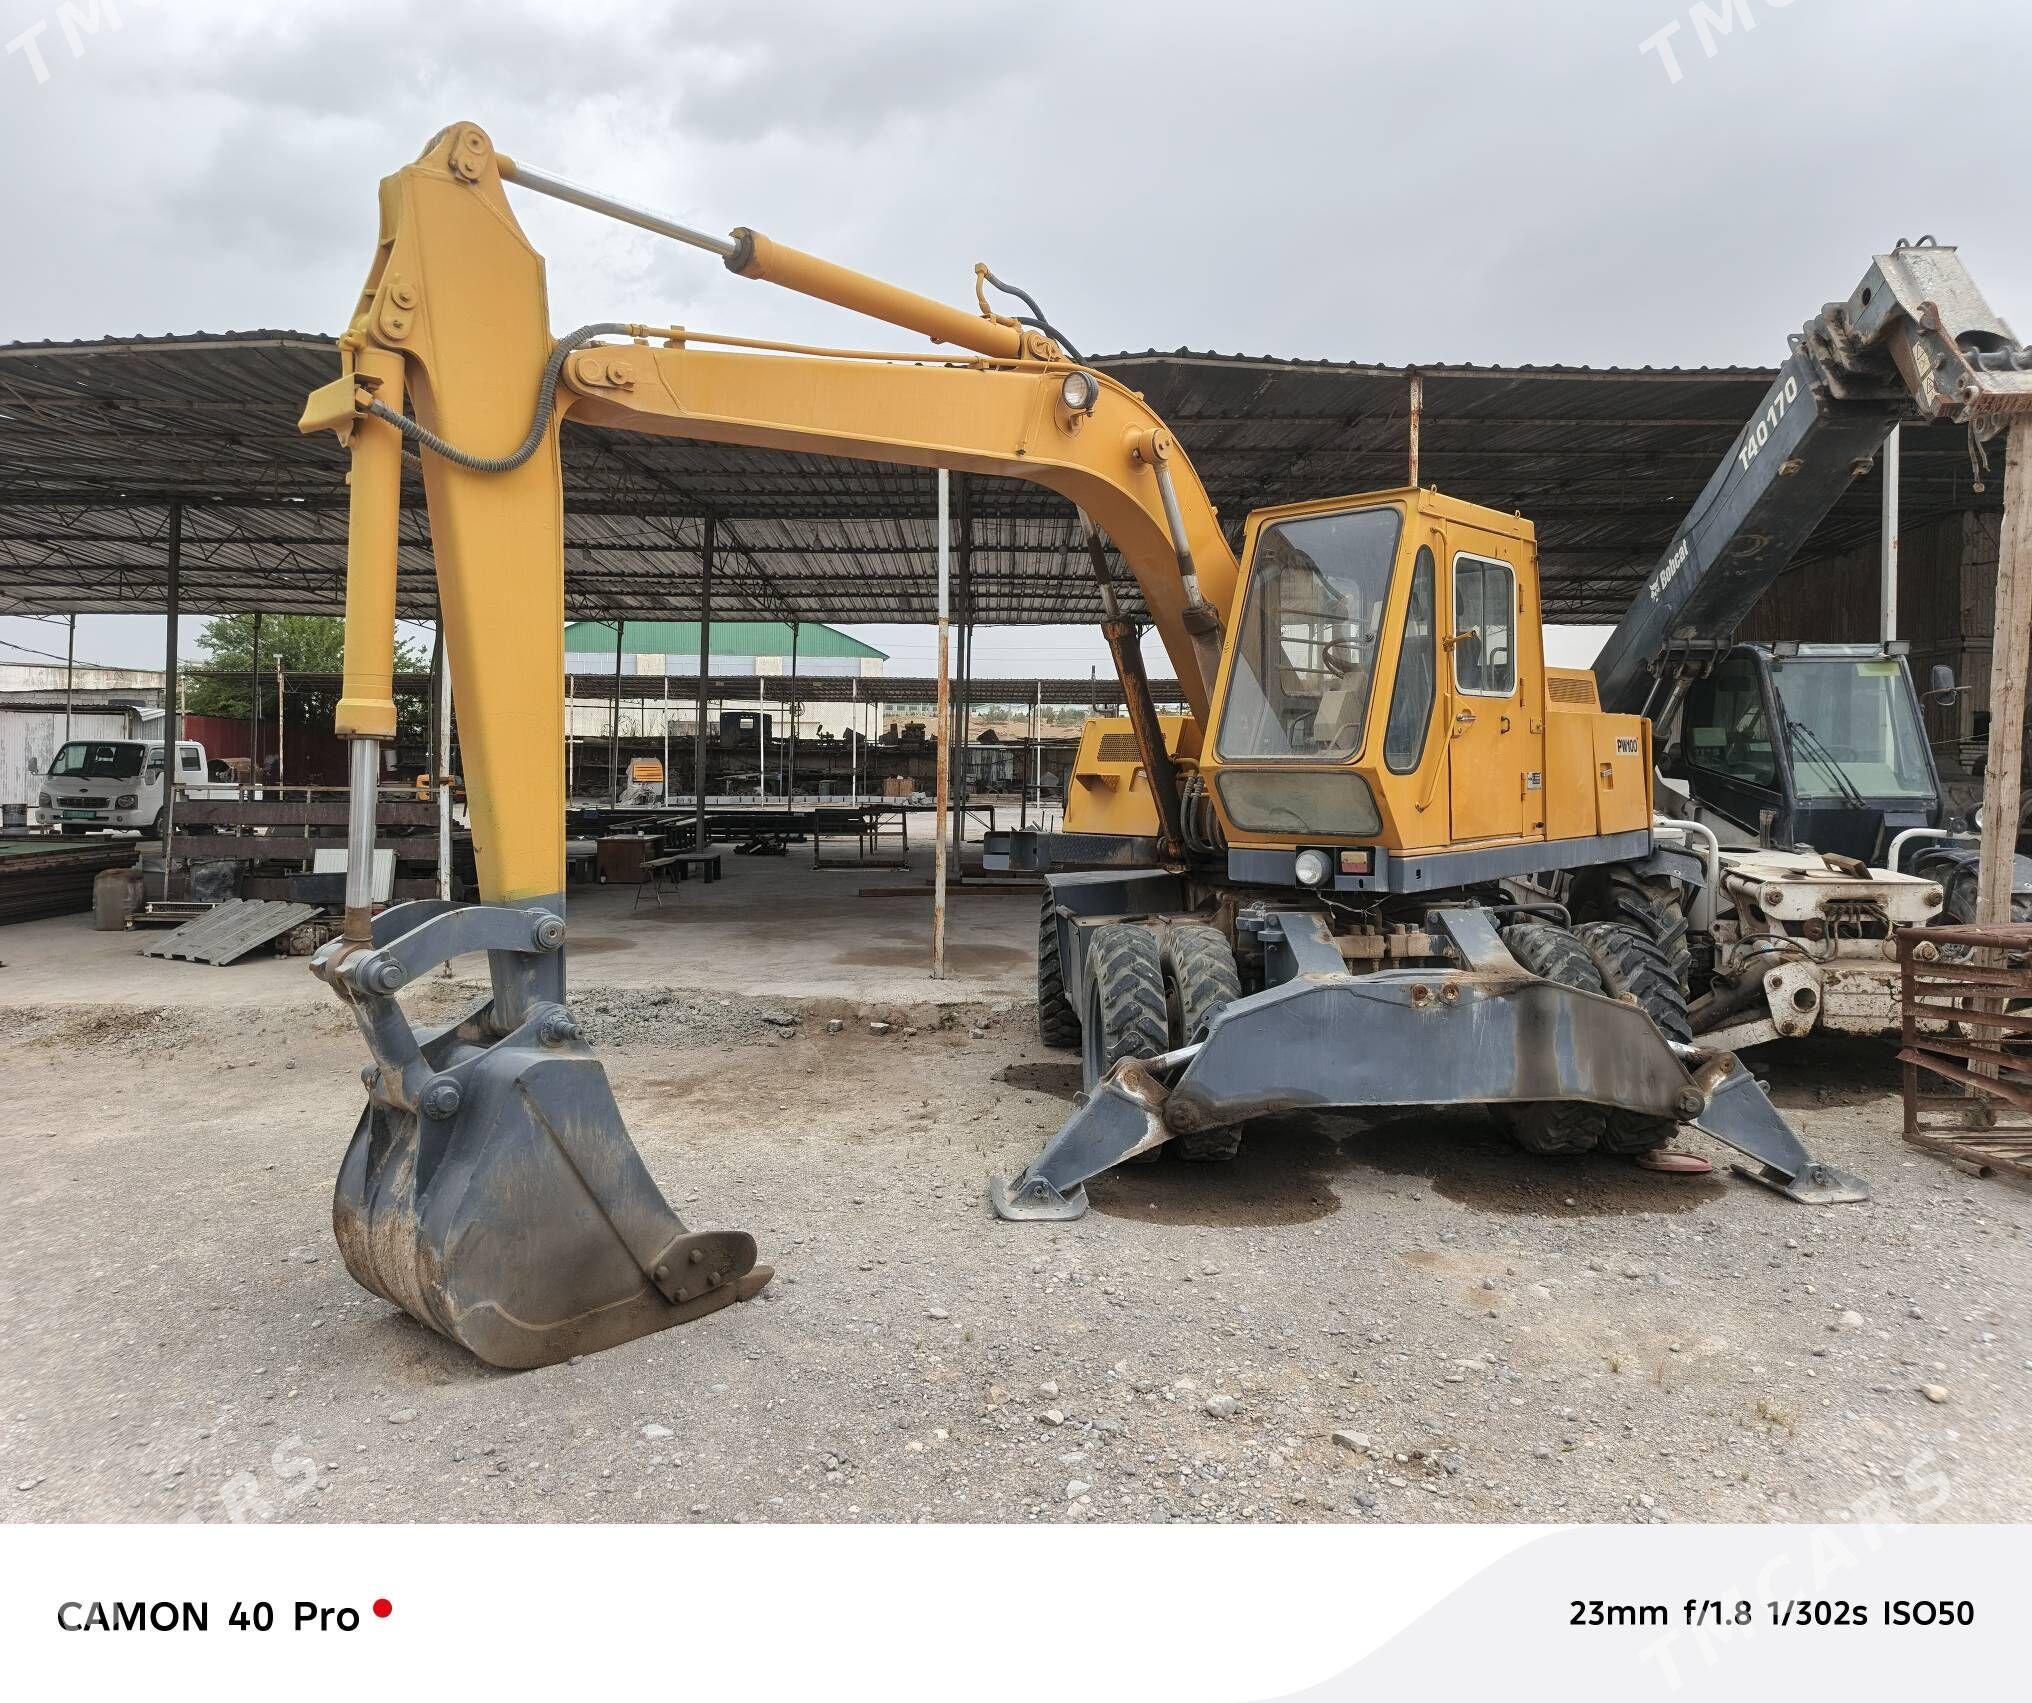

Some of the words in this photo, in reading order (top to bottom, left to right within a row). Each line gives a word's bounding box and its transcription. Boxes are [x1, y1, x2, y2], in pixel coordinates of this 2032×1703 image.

[1738, 376, 1798, 471] T40170
[1659, 538, 1690, 591] Bobcat
[1617, 738, 1638, 753] PW100
